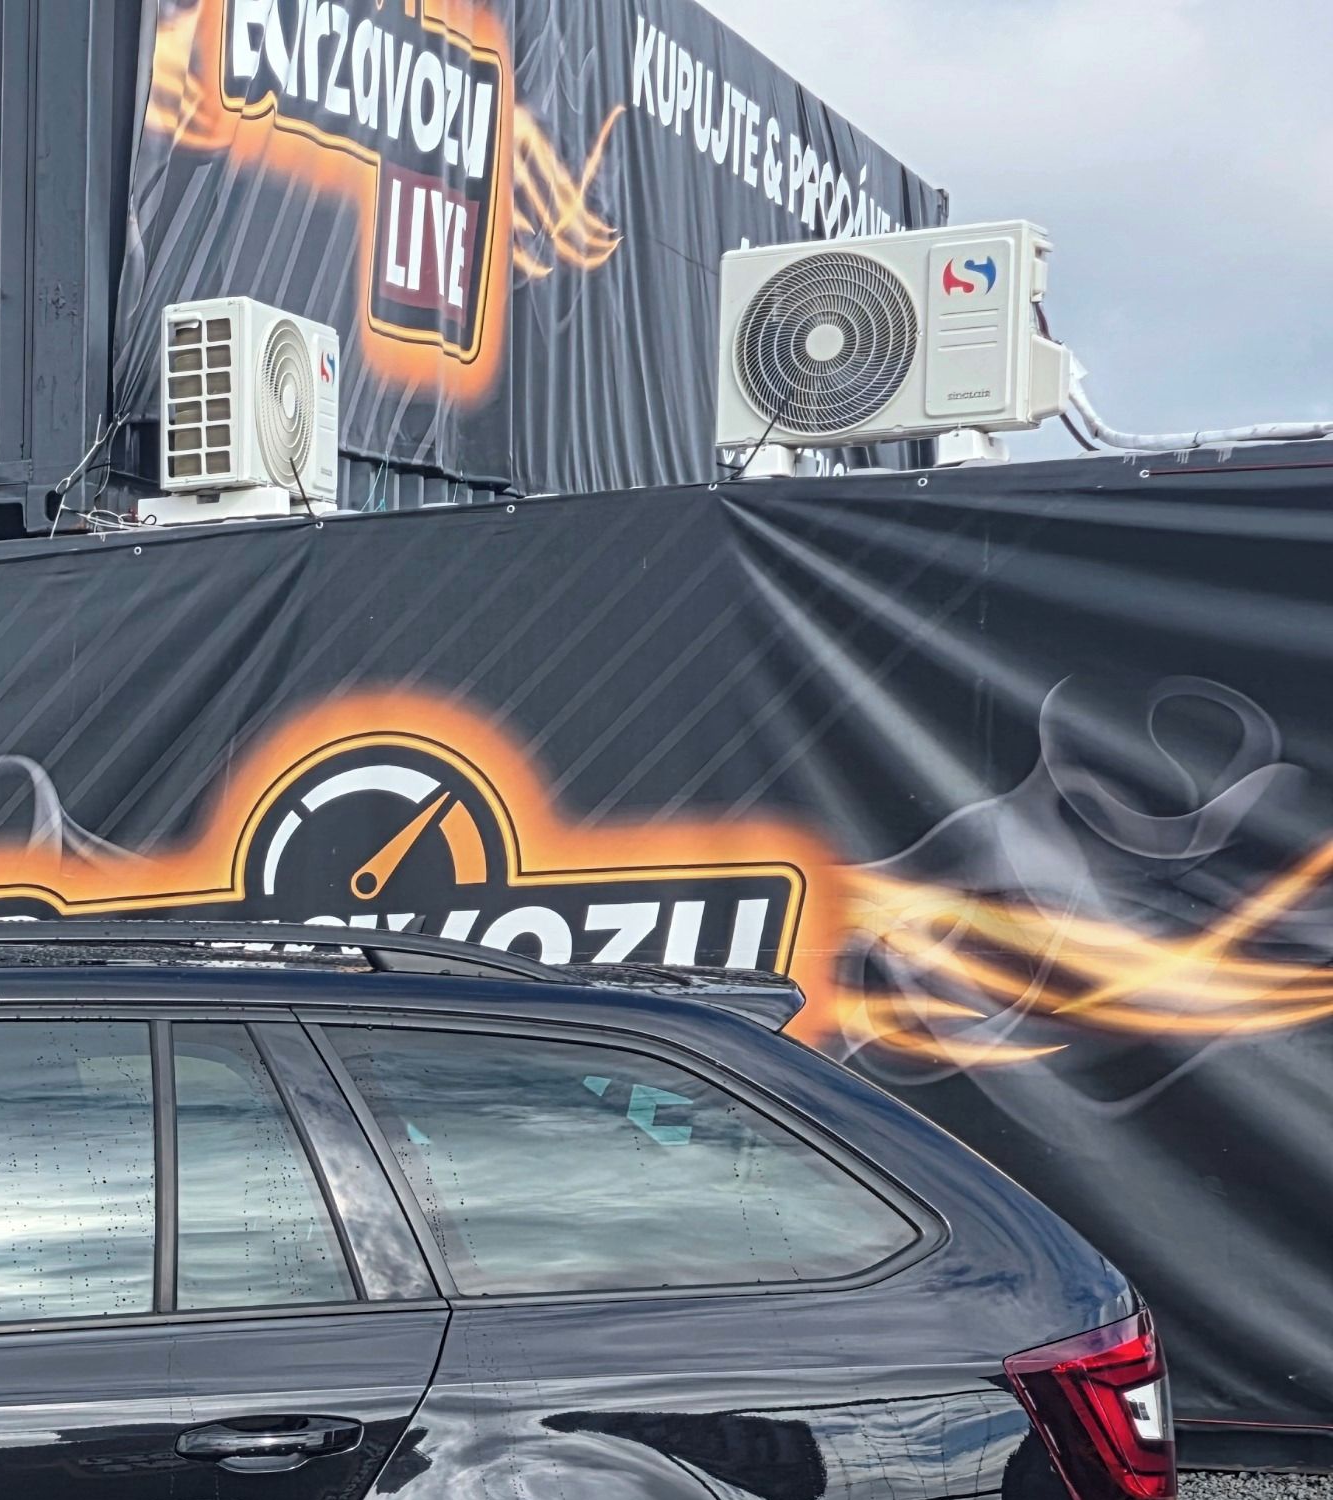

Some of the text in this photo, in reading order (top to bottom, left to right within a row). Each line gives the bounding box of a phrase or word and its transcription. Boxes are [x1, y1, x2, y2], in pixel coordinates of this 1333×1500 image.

[633, 14, 760, 188] KUPUJTE
[763, 117, 783, 206] &
[385, 178, 467, 309] LIVE
